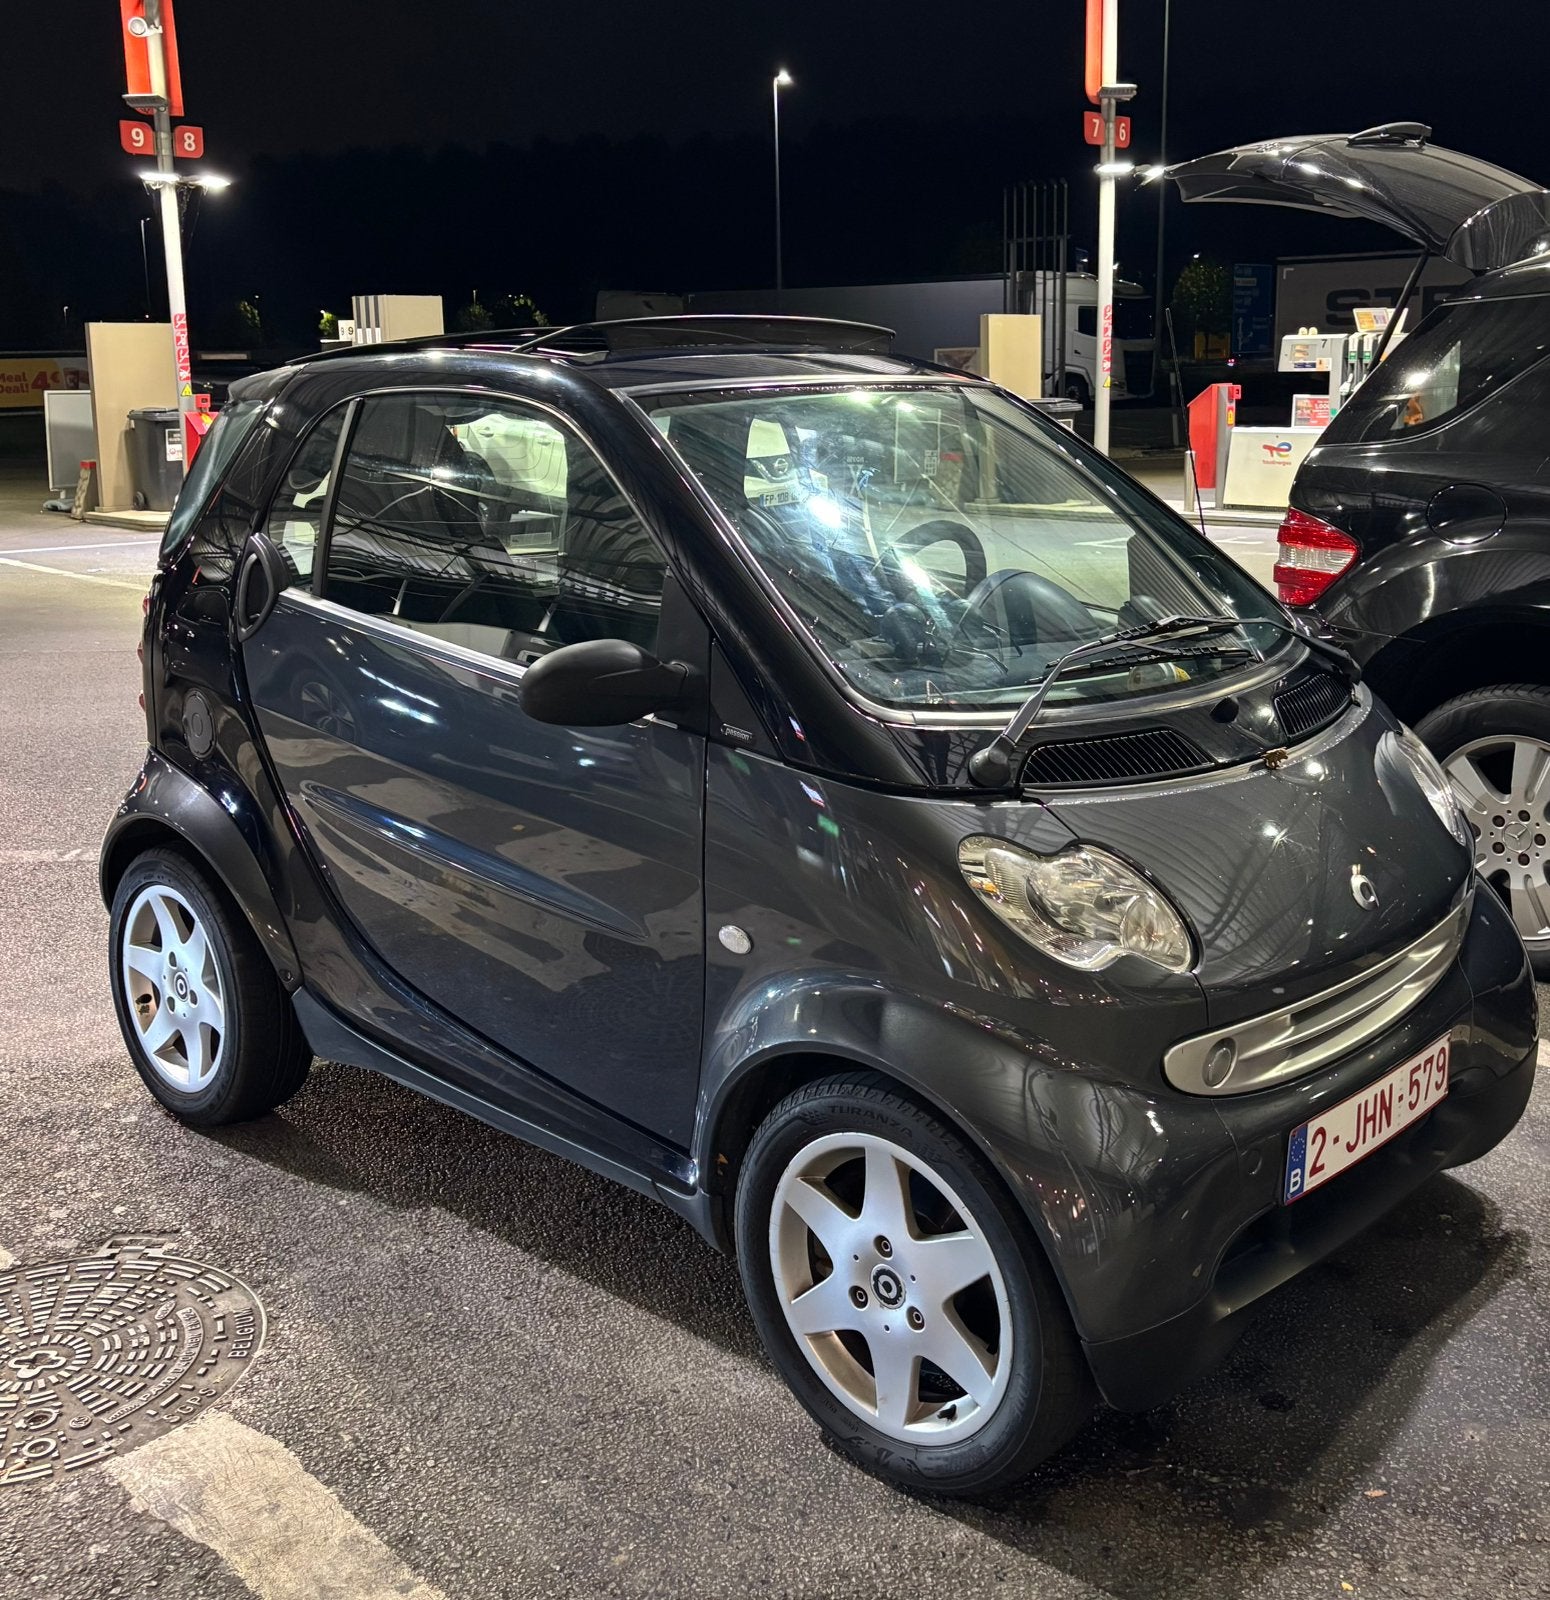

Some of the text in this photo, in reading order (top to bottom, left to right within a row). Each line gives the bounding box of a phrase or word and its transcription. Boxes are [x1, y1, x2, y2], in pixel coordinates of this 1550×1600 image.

[131, 127, 145, 148] 9
[1092, 118, 1100, 138] 7
[1119, 122, 1126, 142] 6
[183, 132, 196, 152] 8
[348, 326, 354, 336] 9
[1321, 338, 1328, 349] 7
[725, 727, 750, 741] passion
[828, 1104, 913, 1138] TURANZA
[1309, 1046, 1447, 1178] 2-JHN-579
[1289, 1168, 1302, 1193] B
[227, 1307, 255, 1359] BELGIUM
